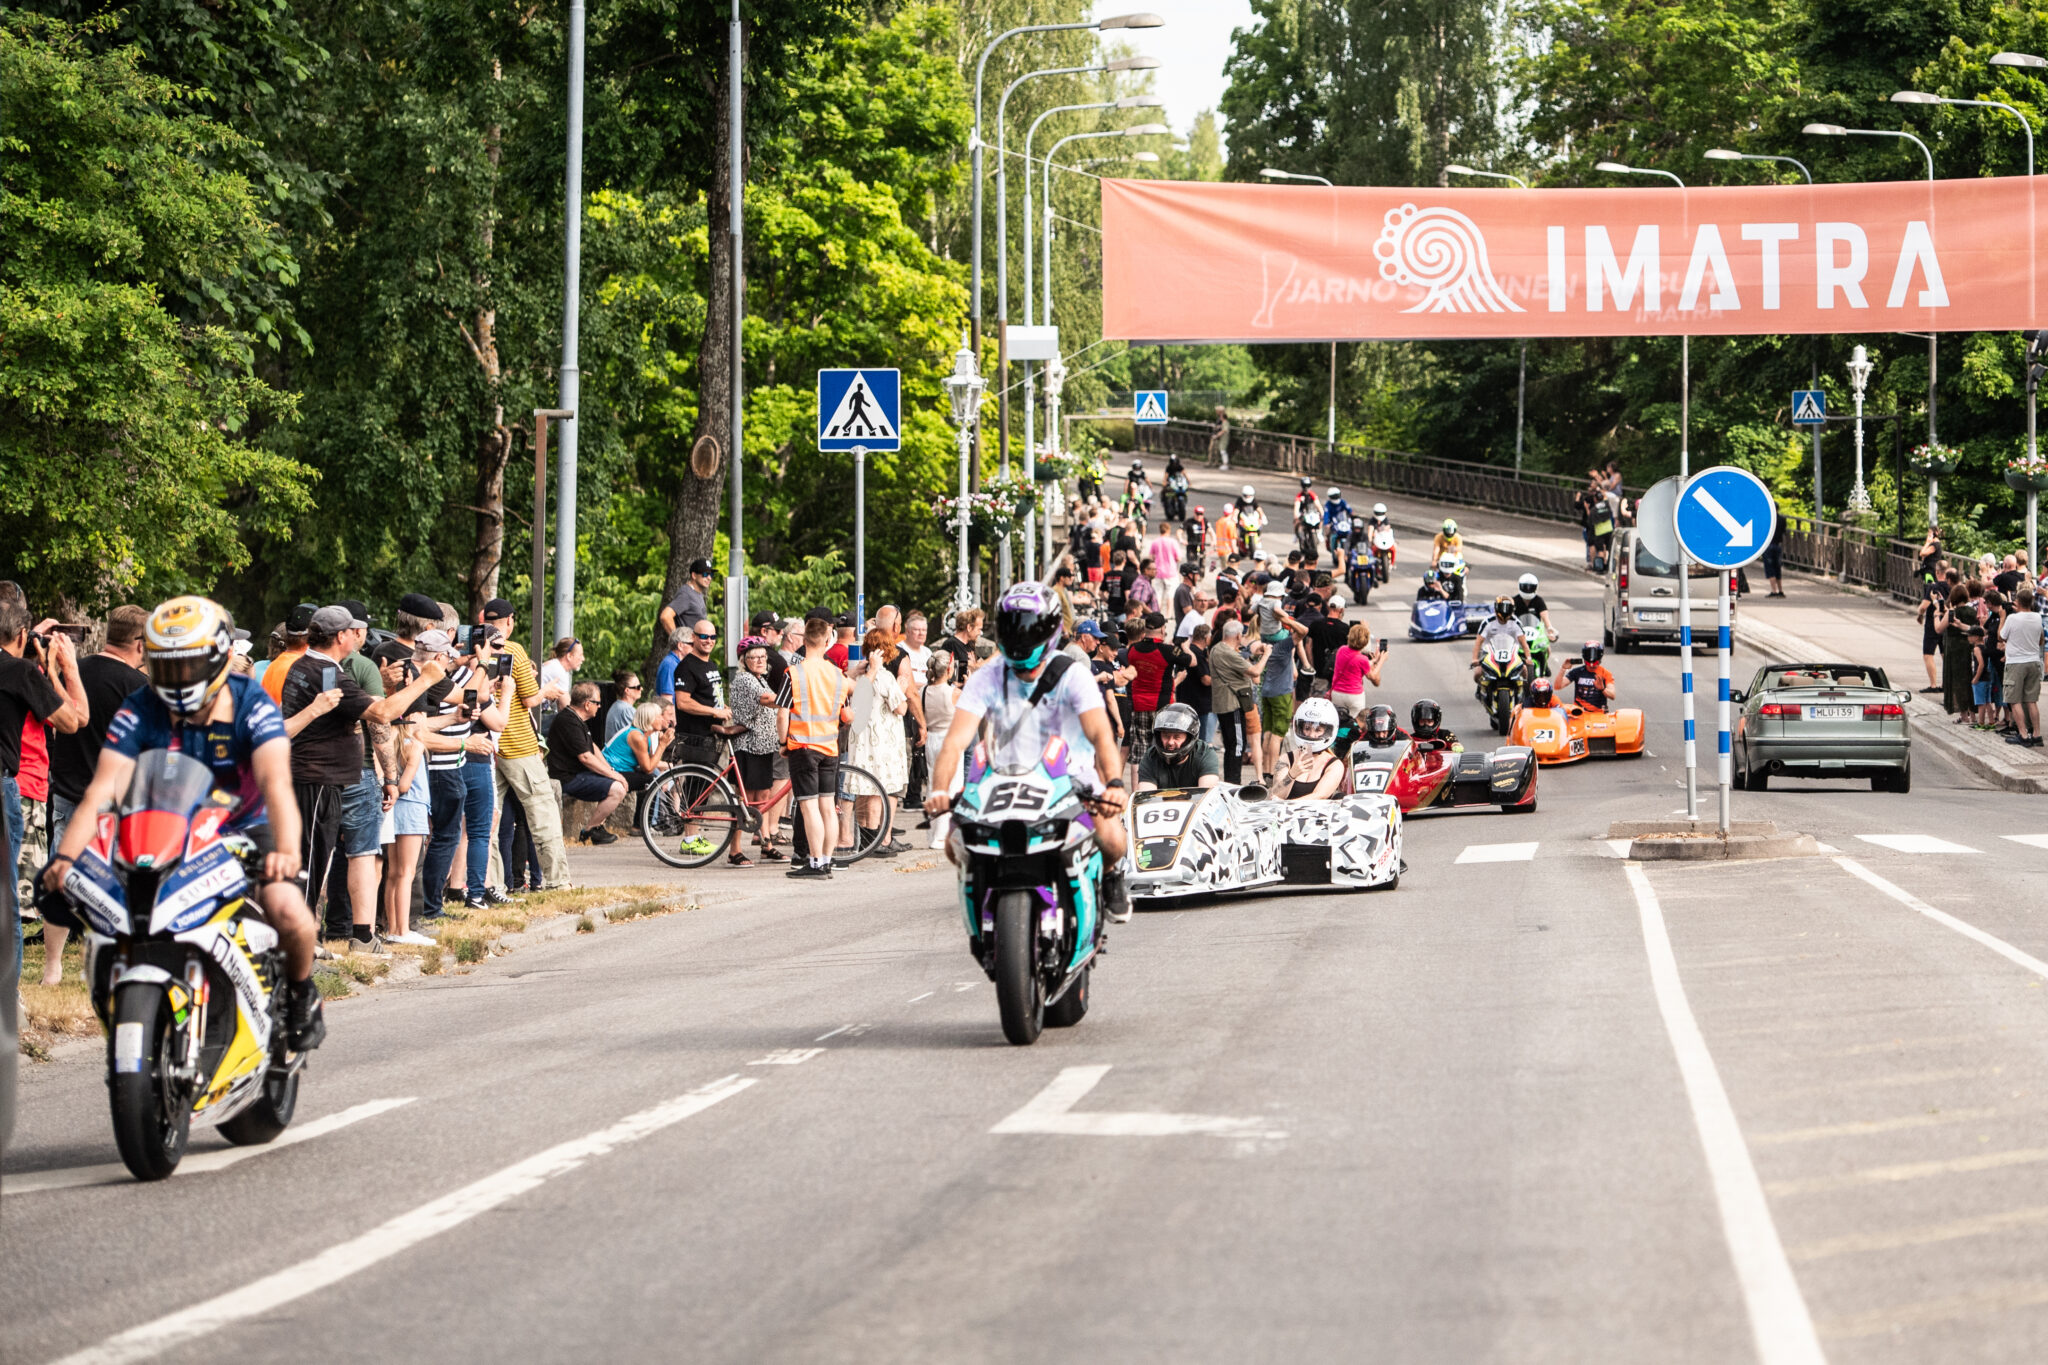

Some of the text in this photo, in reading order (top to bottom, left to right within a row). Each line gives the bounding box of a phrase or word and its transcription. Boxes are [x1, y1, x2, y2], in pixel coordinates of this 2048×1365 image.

[1547, 221, 1951, 312] IMATRA
[1286, 277, 1398, 303] JARNO
[1498, 651, 1508, 659] 13
[1816, 706, 1853, 716] MLU-139
[1534, 730, 1553, 739] 21
[1360, 774, 1383, 787] 41
[983, 782, 1048, 815] 65
[1143, 809, 1180, 824] 69
[178, 869, 231, 906] SUVIC
